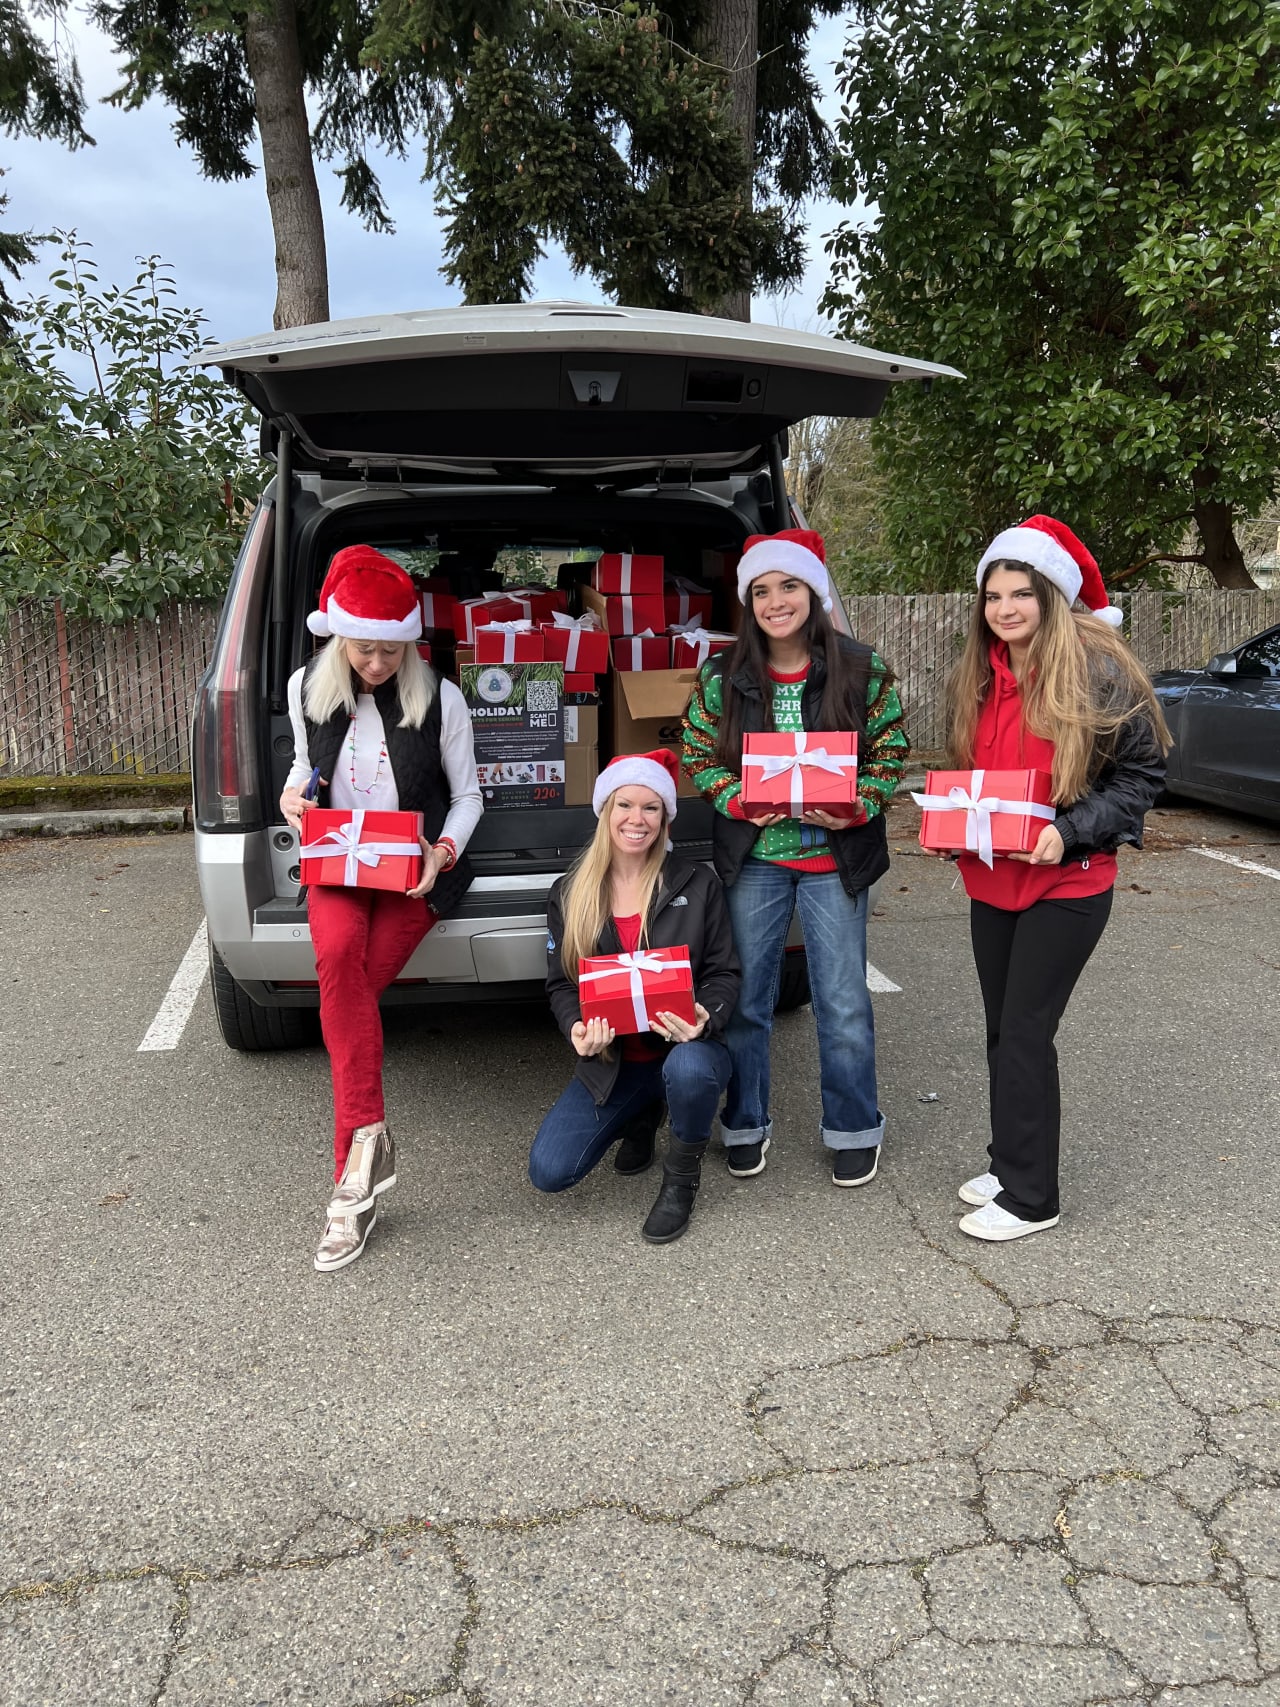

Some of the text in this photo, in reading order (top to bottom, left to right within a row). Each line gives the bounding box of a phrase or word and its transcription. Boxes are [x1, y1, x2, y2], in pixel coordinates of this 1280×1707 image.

[775, 684, 803, 697] MY
[772, 699, 801, 711] CHR
[468, 706, 523, 717] HOLIDAY
[529, 718, 548, 728] ME
[772, 713, 803, 724] EAT
